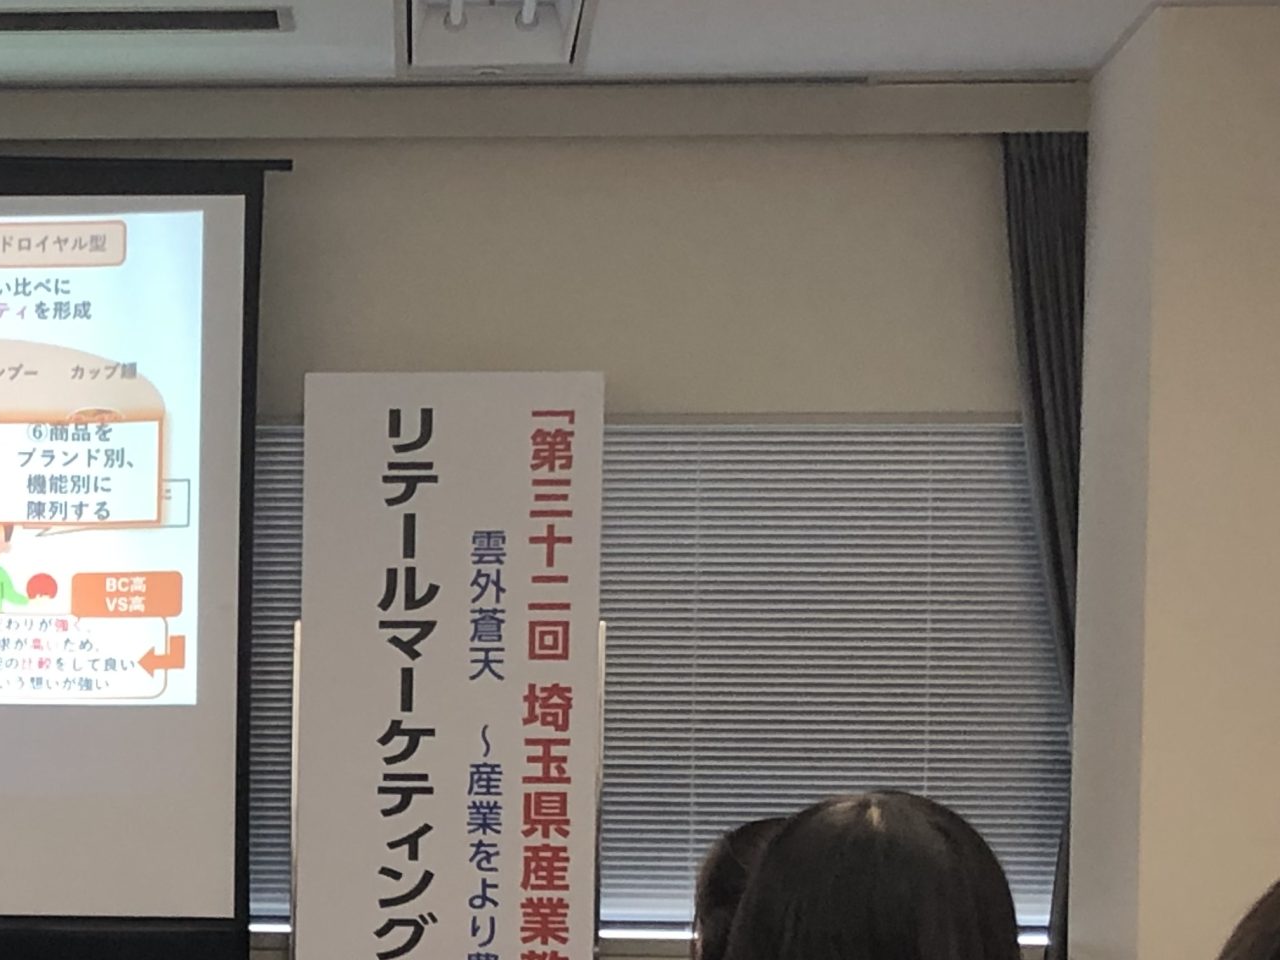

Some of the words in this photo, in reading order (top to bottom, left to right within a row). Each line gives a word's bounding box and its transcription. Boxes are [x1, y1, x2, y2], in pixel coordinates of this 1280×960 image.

[18, 446, 137, 469] ブランド別、
[26, 473, 112, 494] 機能別に
[26, 499, 111, 521] 陳列する
[105, 576, 146, 592] BC高
[105, 596, 145, 611] VS高
[468, 530, 508, 682] 雲外蒼天
